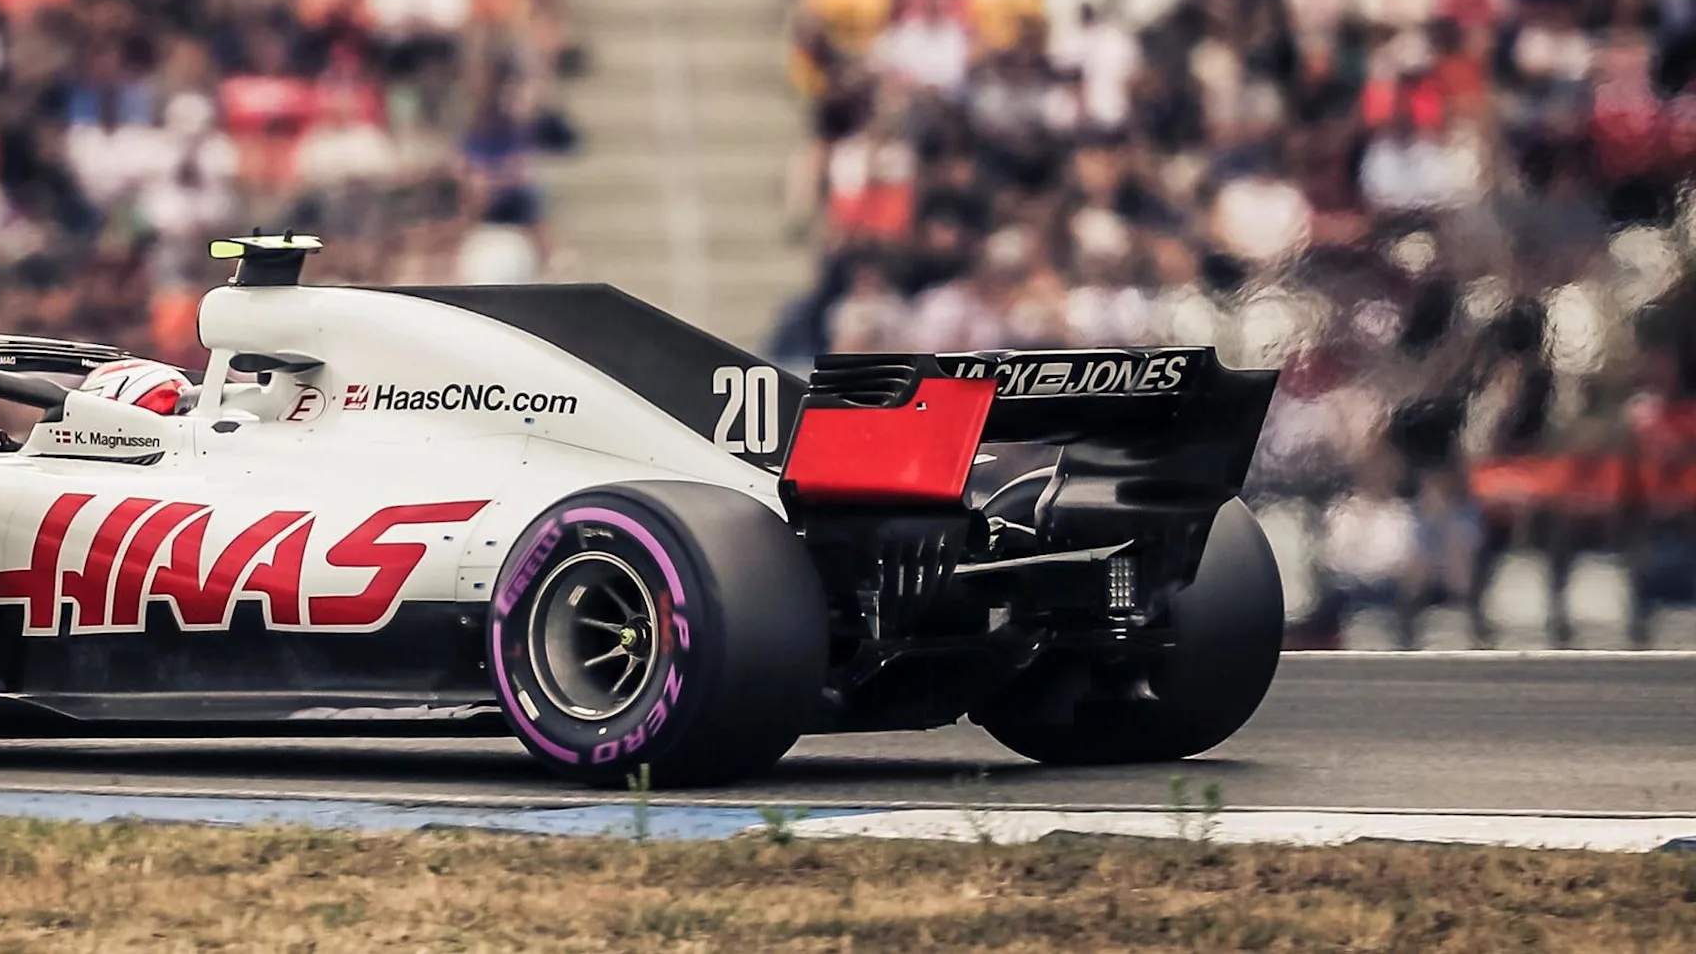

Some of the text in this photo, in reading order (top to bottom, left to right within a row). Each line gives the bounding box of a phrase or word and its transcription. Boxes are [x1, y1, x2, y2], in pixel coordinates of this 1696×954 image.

[1065, 356, 1188, 394] JONES
[373, 384, 578, 415] HaasCNC.com
[713, 366, 779, 454] 20
[75, 431, 161, 449] K. Magnussen
[592, 612, 690, 764] P ZERO
